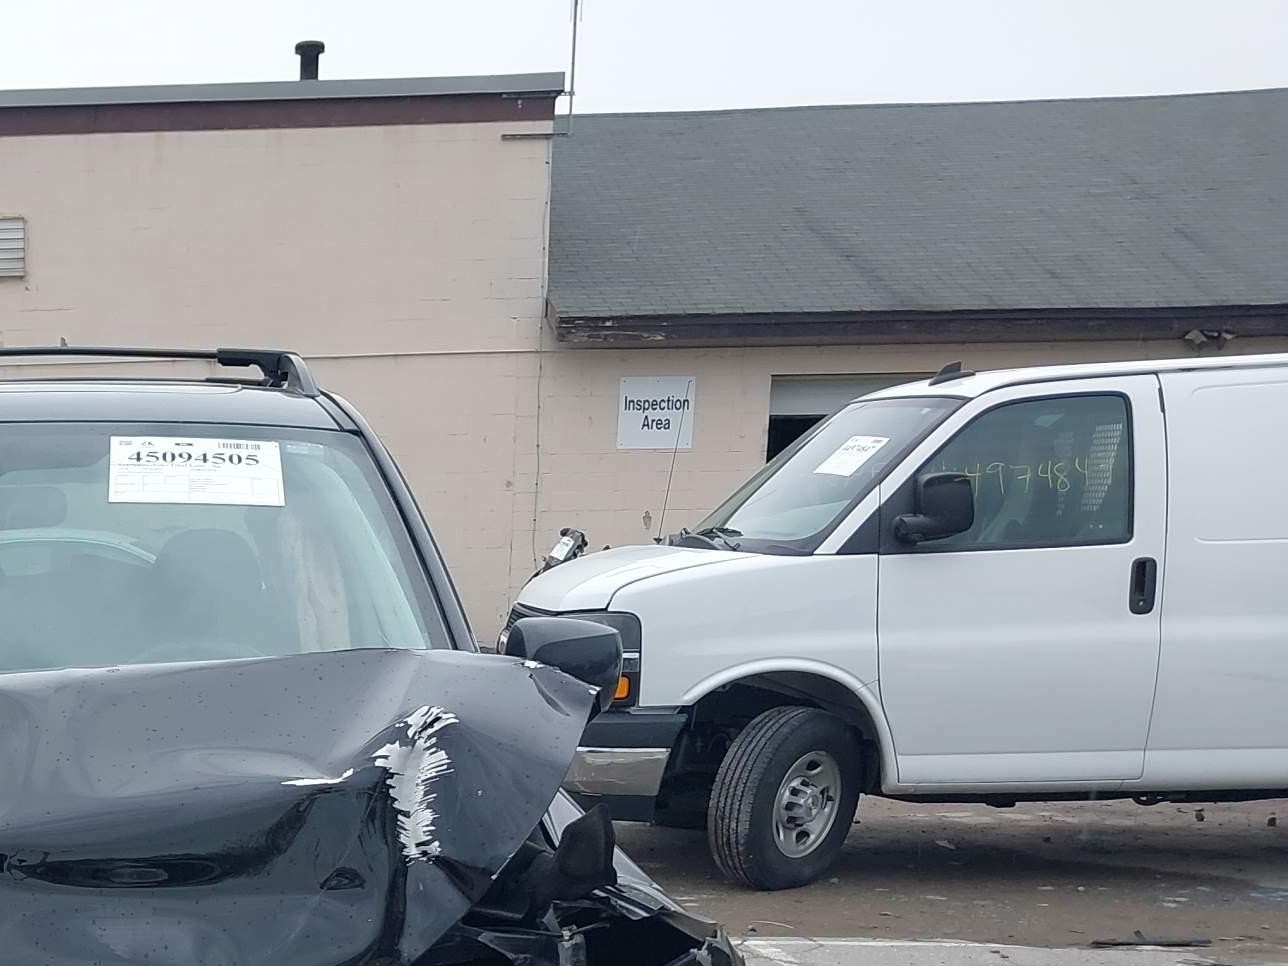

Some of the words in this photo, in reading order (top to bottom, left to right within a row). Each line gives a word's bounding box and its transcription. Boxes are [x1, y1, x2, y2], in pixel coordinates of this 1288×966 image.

[623, 395, 691, 414] Inspection
[640, 415, 671, 431] Area
[128, 451, 260, 466] 45094505
